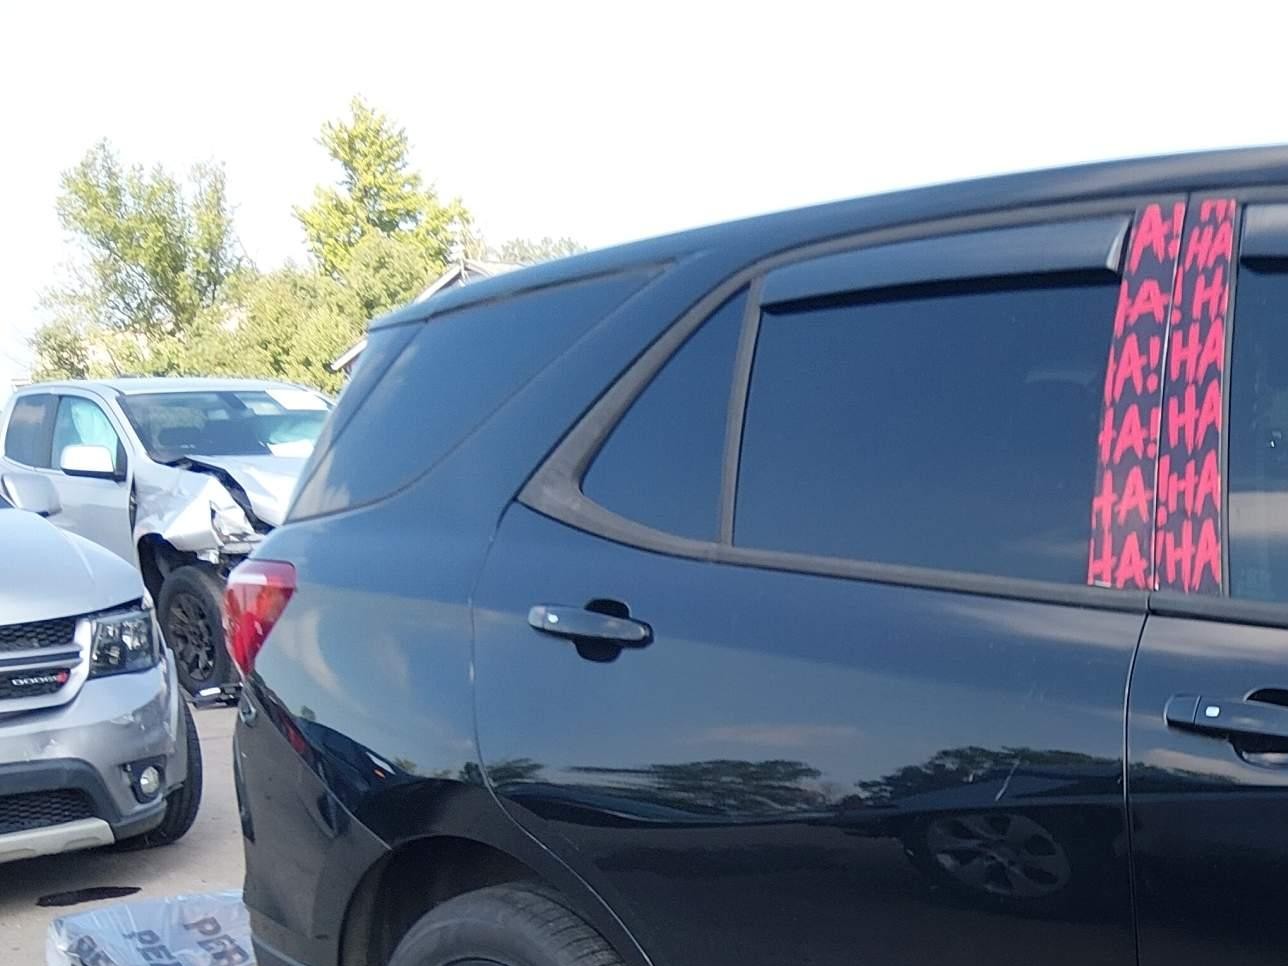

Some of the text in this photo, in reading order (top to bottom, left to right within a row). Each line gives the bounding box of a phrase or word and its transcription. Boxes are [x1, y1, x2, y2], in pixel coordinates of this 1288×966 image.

[1192, 265, 1229, 321] H
[1170, 317, 1225, 385] HA
[1168, 378, 1222, 455] HA
